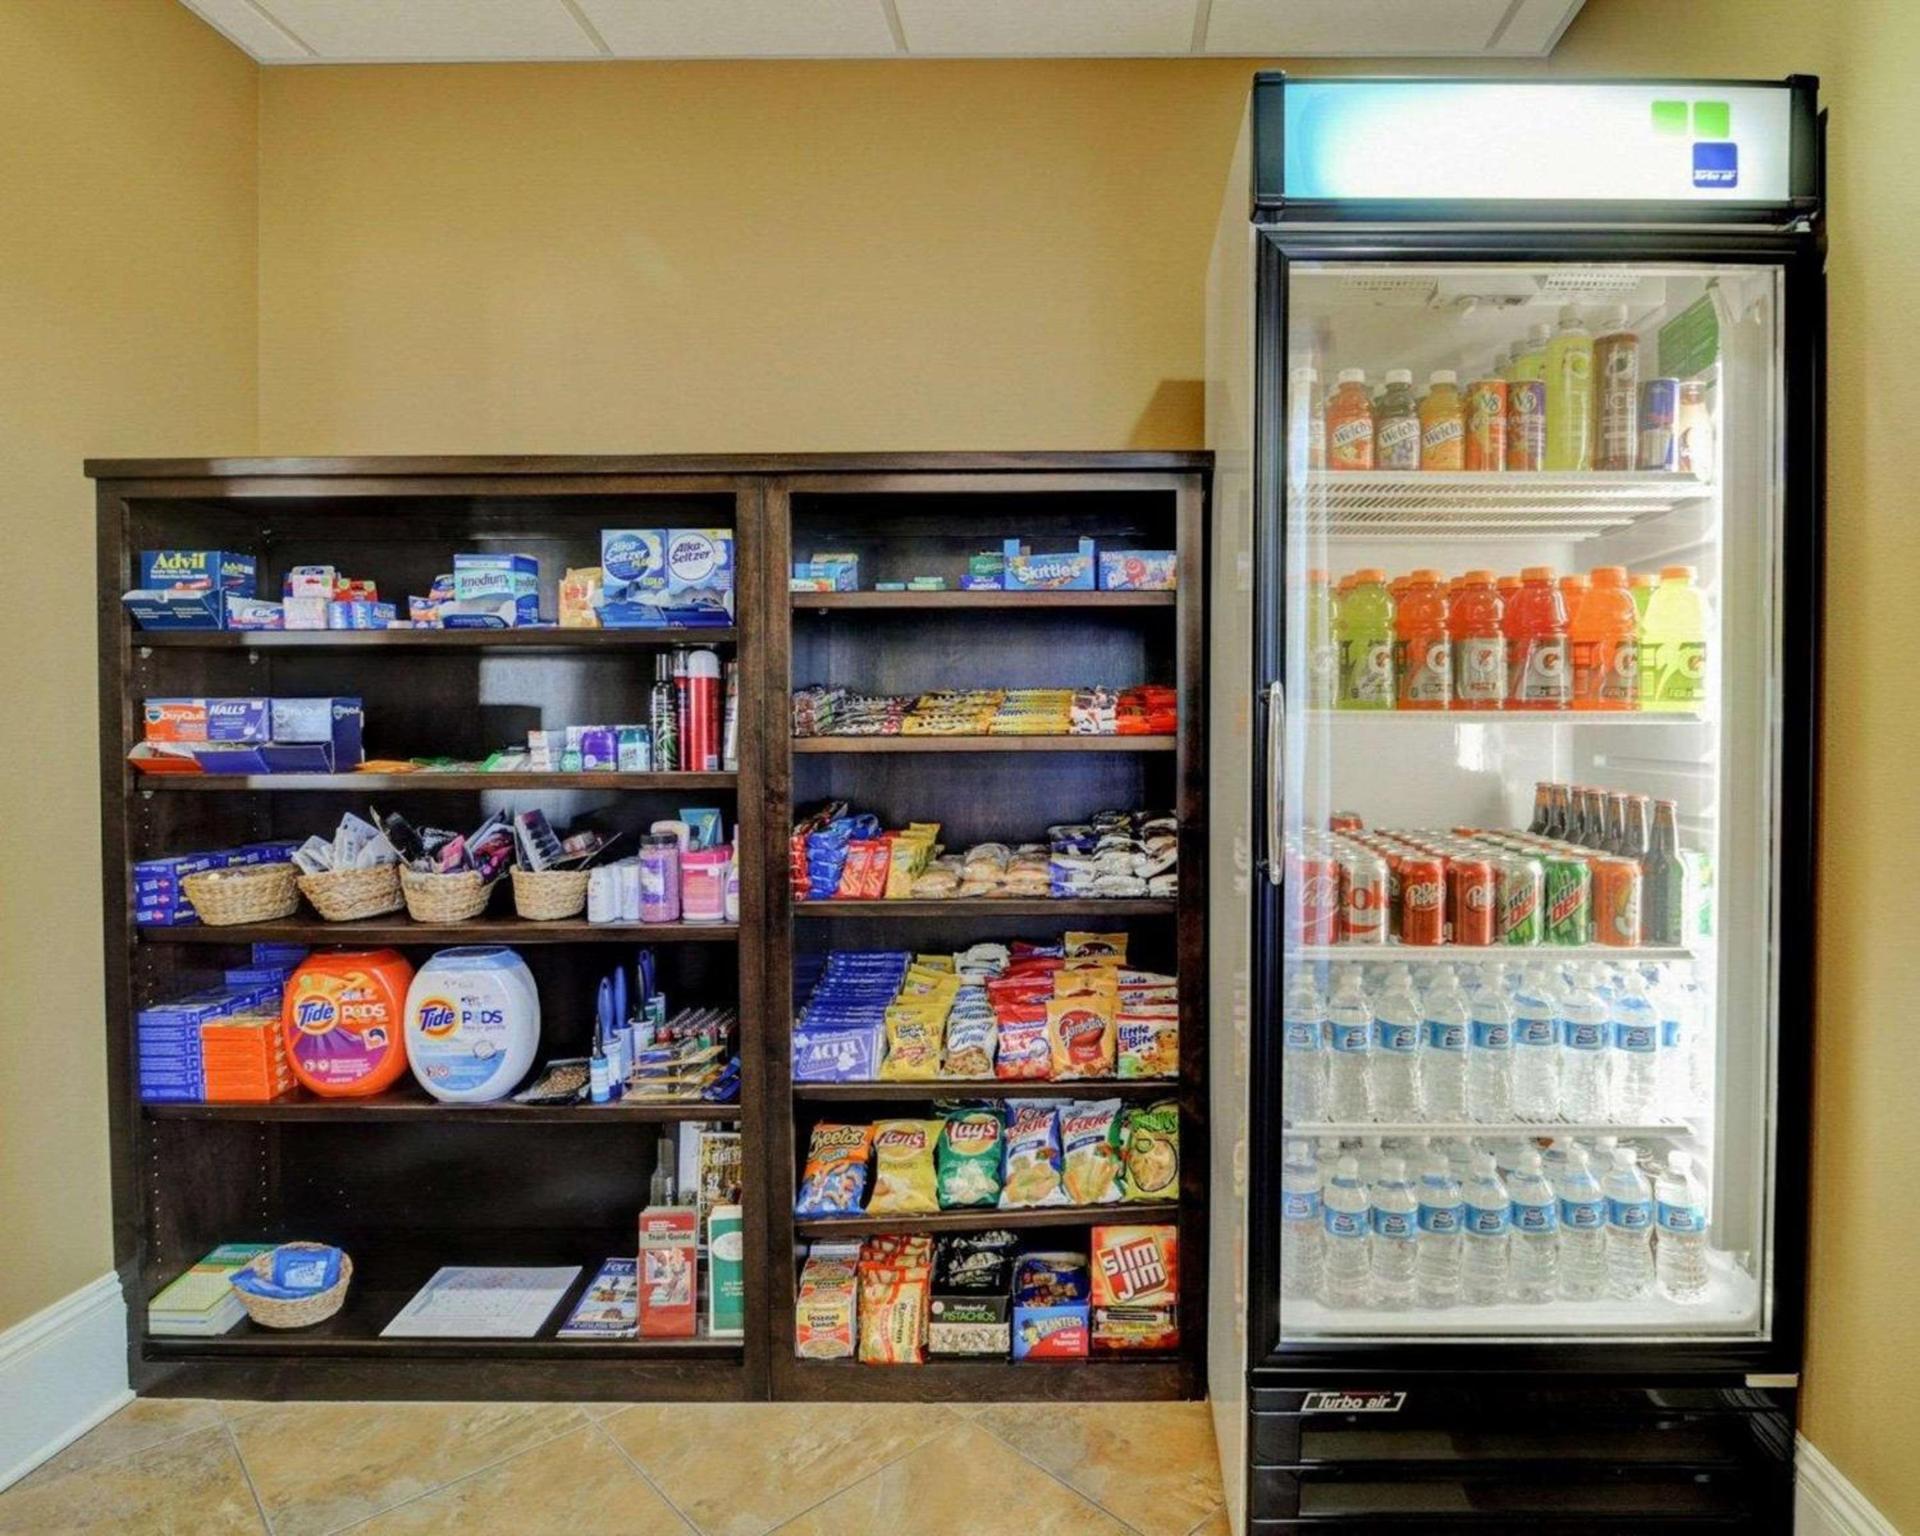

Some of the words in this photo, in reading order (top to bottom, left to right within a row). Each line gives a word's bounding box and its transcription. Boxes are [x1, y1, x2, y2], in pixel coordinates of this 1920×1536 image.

[153, 552, 206, 570] Advil
[461, 573, 509, 588] Imodium
[1017, 562, 1081, 582] Skittles
[209, 704, 246, 716] HALLS
[298, 1002, 335, 1027] Tide
[420, 1007, 456, 1031] Tide
[1118, 1024, 1150, 1039] Little
[950, 1119, 998, 1142] Lay's
[942, 1311, 996, 1322] PISTACHIOS
[1038, 1316, 1083, 1333] PLANTERS
[1318, 1393, 1363, 1409] Turbo
[1365, 1394, 1392, 1409] air
